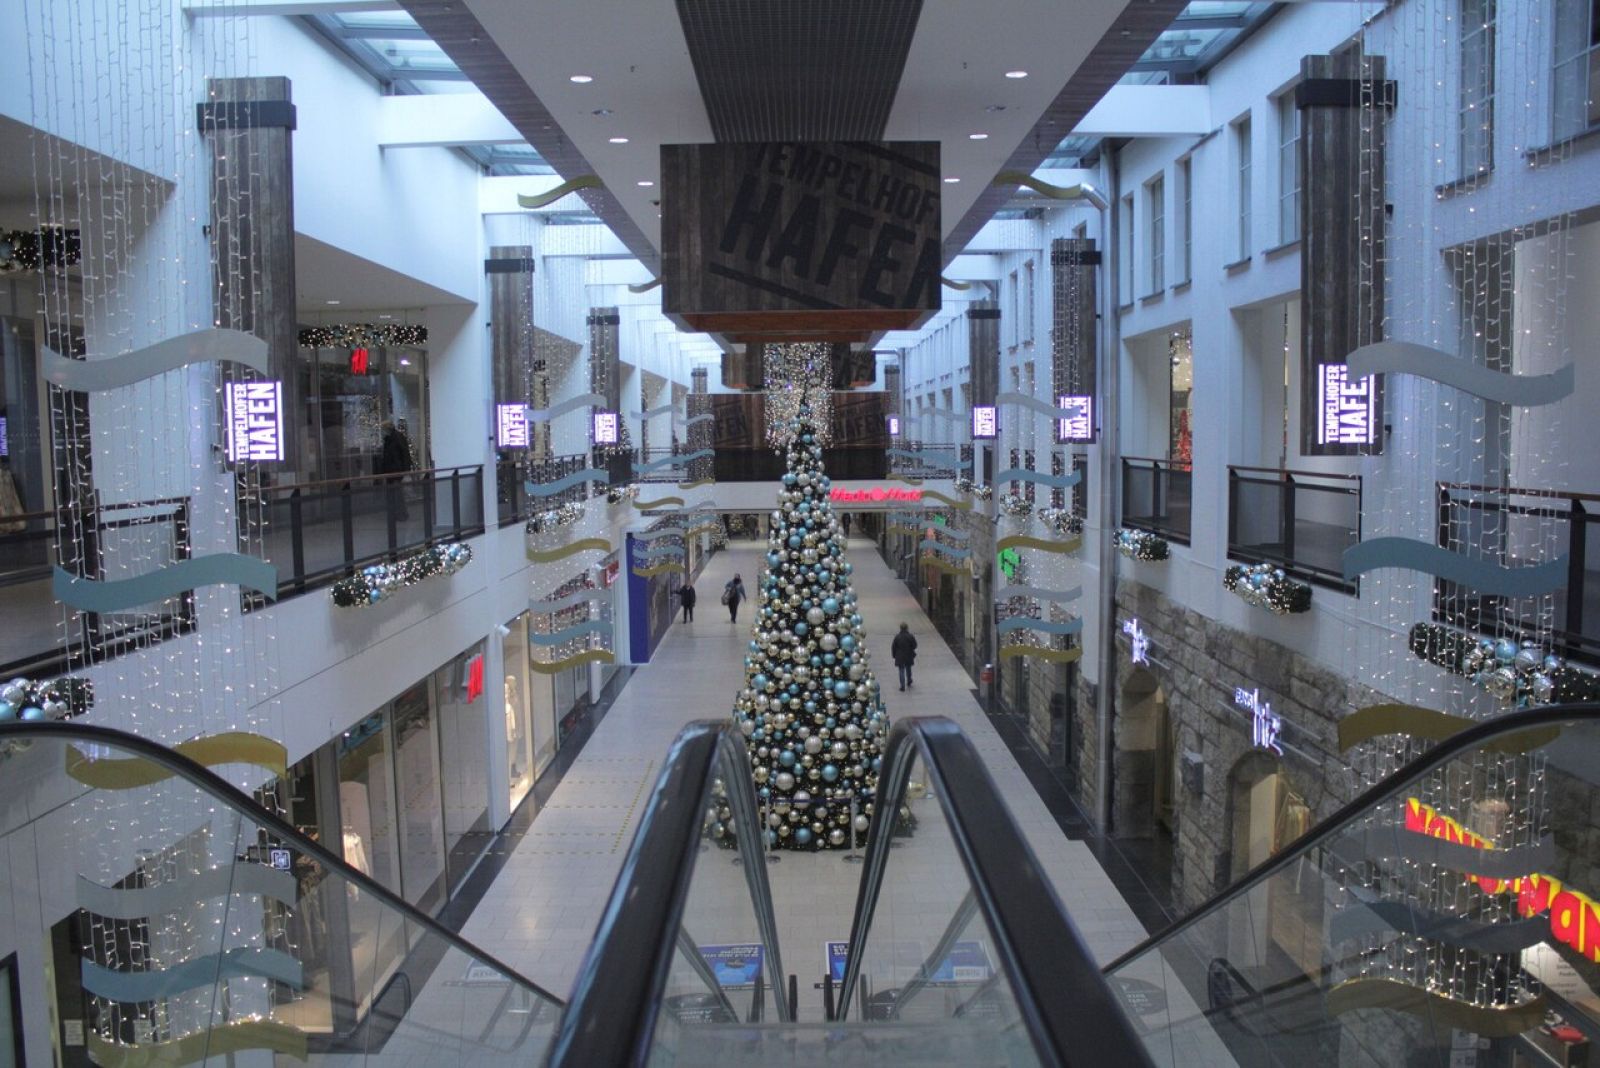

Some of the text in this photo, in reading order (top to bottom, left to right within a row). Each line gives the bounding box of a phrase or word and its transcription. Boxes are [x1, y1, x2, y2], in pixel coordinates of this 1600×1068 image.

[234, 383, 250, 461] TEMPELHOFER
[247, 383, 277, 460] HAFEN
[509, 404, 525, 446] HAFEN
[1326, 365, 1339, 443] TEMPELHOFER
[1340, 365, 1368, 443] HAFE
